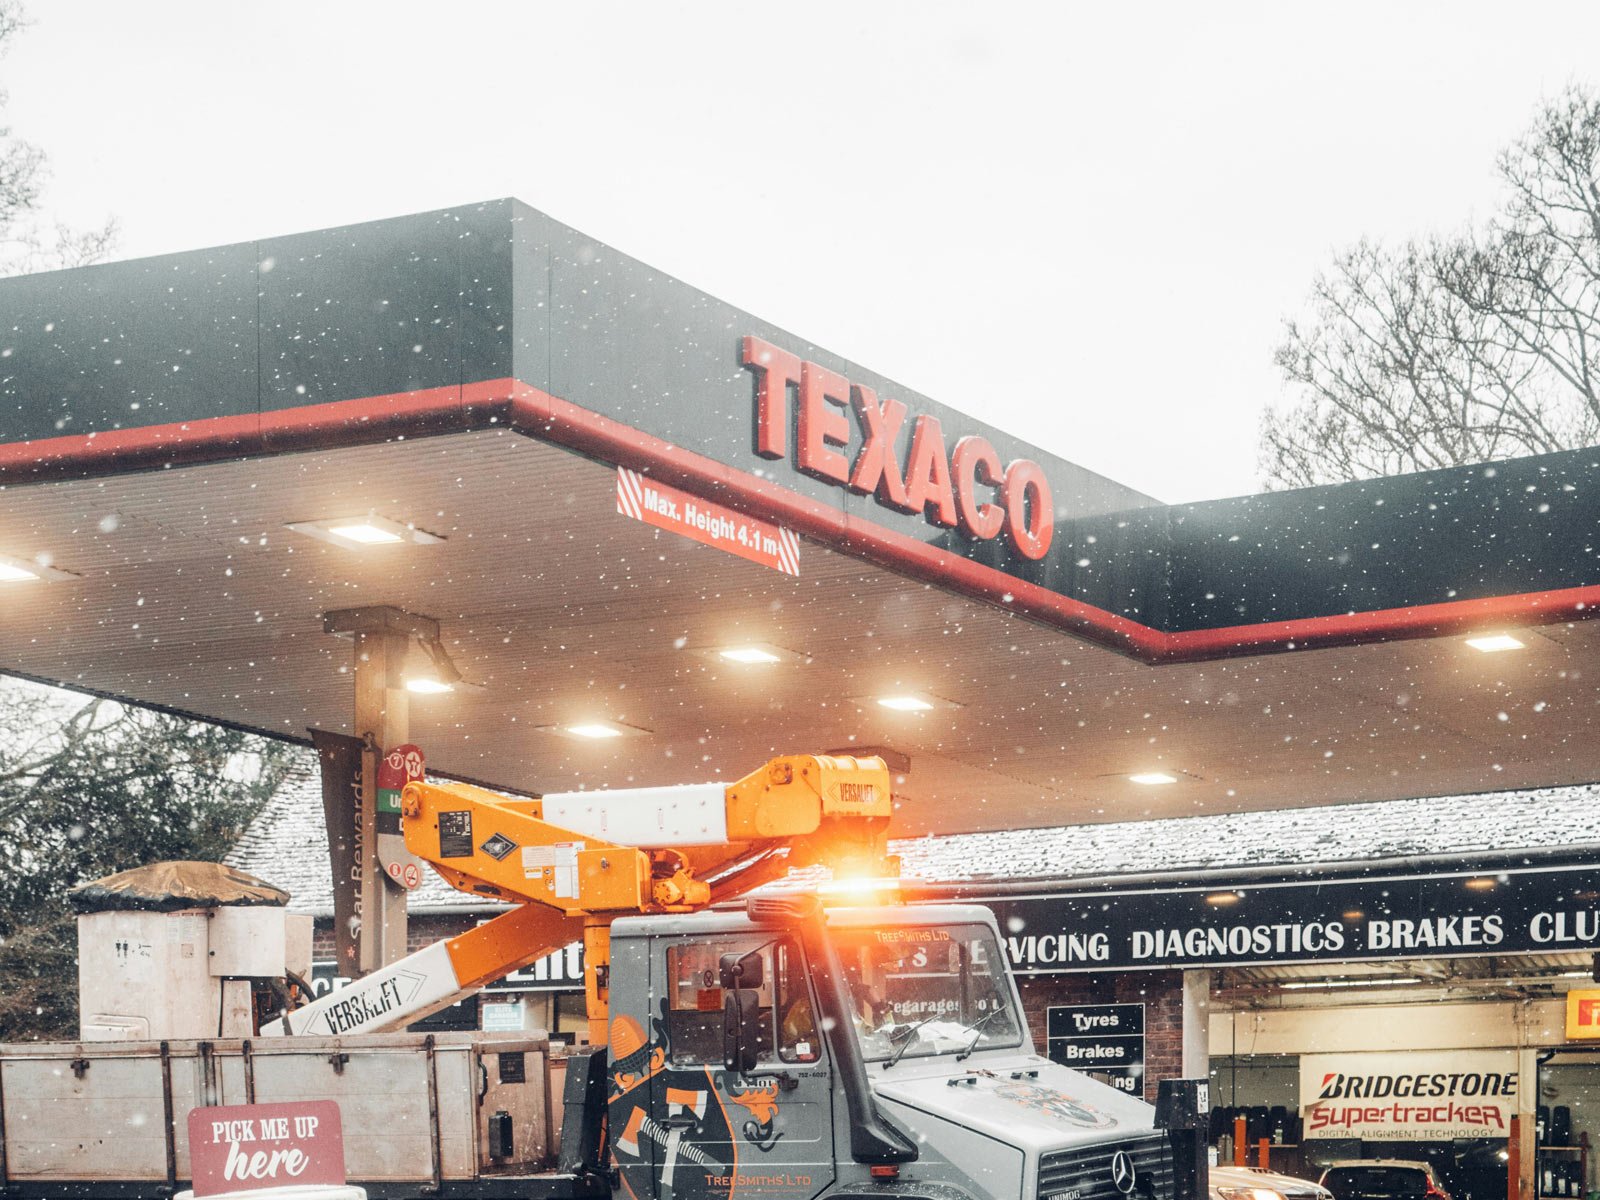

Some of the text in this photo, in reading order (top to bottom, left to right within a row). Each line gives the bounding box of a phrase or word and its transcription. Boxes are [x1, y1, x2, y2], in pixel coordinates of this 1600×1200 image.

[743, 335, 1054, 560] TEXACO
[644, 487, 777, 556] Max. Height 4.1 m
[840, 783, 873, 803] VERSALIFT
[1132, 921, 1344, 959] DIAGNOSTICS
[1368, 914, 1504, 950] BRAKES
[1530, 911, 1600, 943] CLU
[1072, 1014, 1119, 1031] Tyres
[1066, 1044, 1125, 1059] Brakes
[1319, 1073, 1518, 1099] BRIDGESTONE
[212, 1116, 319, 1143] PICK ME UP
[1319, 1129, 1494, 1138] DIGITAL ALIGNMENT TECHNOLOGY
[224, 1139, 309, 1181] here
